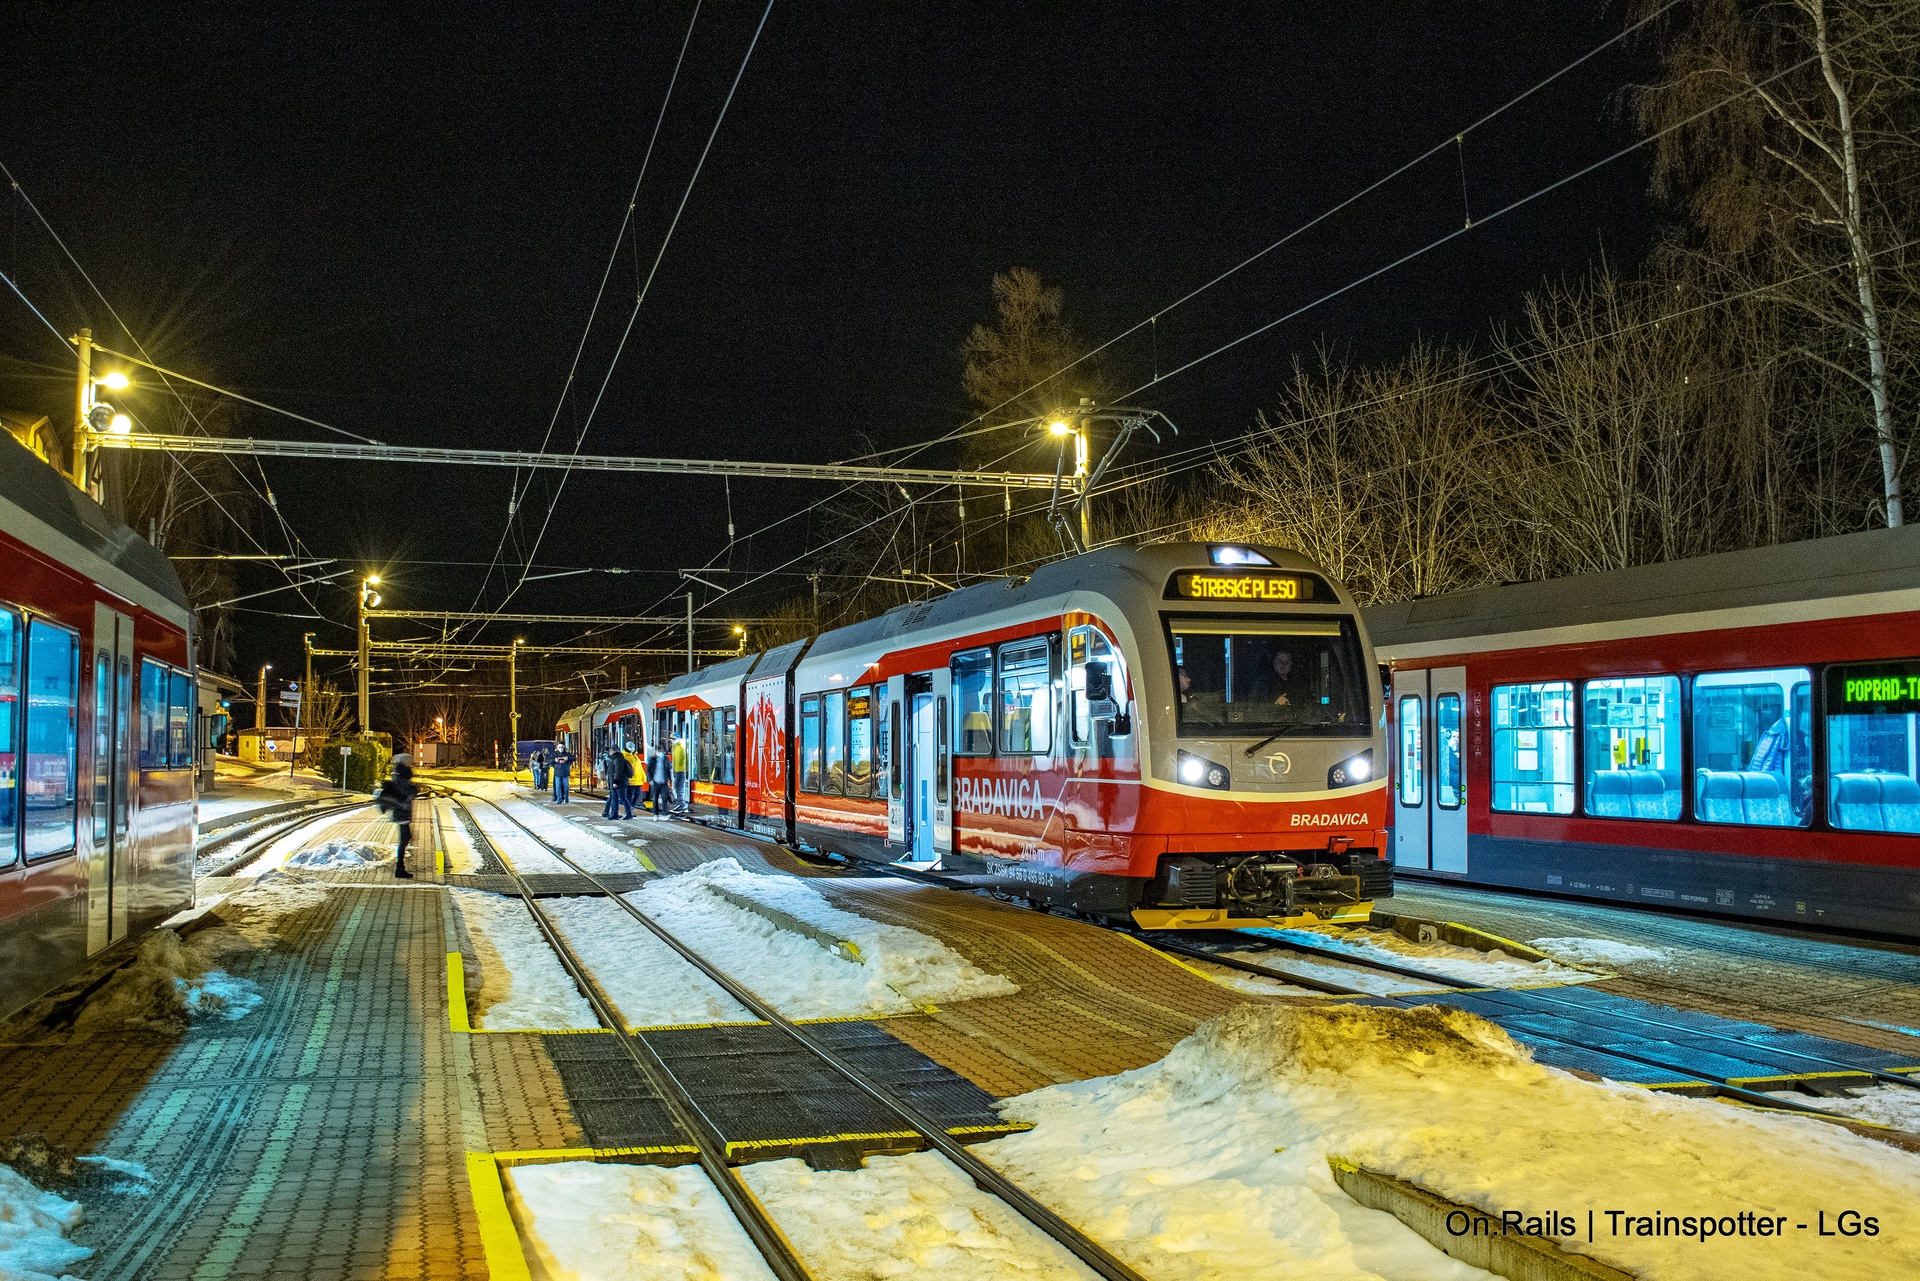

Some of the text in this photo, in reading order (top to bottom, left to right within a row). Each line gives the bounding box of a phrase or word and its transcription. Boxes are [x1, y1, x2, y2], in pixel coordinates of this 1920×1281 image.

[1191, 575, 1296, 599] ŠTRBSKÉ PLESO
[1846, 677, 1920, 702] POPRAD-T
[953, 777, 1045, 820] BRADAVICA
[1290, 813, 1369, 826] BRADAVICA
[986, 861, 994, 875] SK
